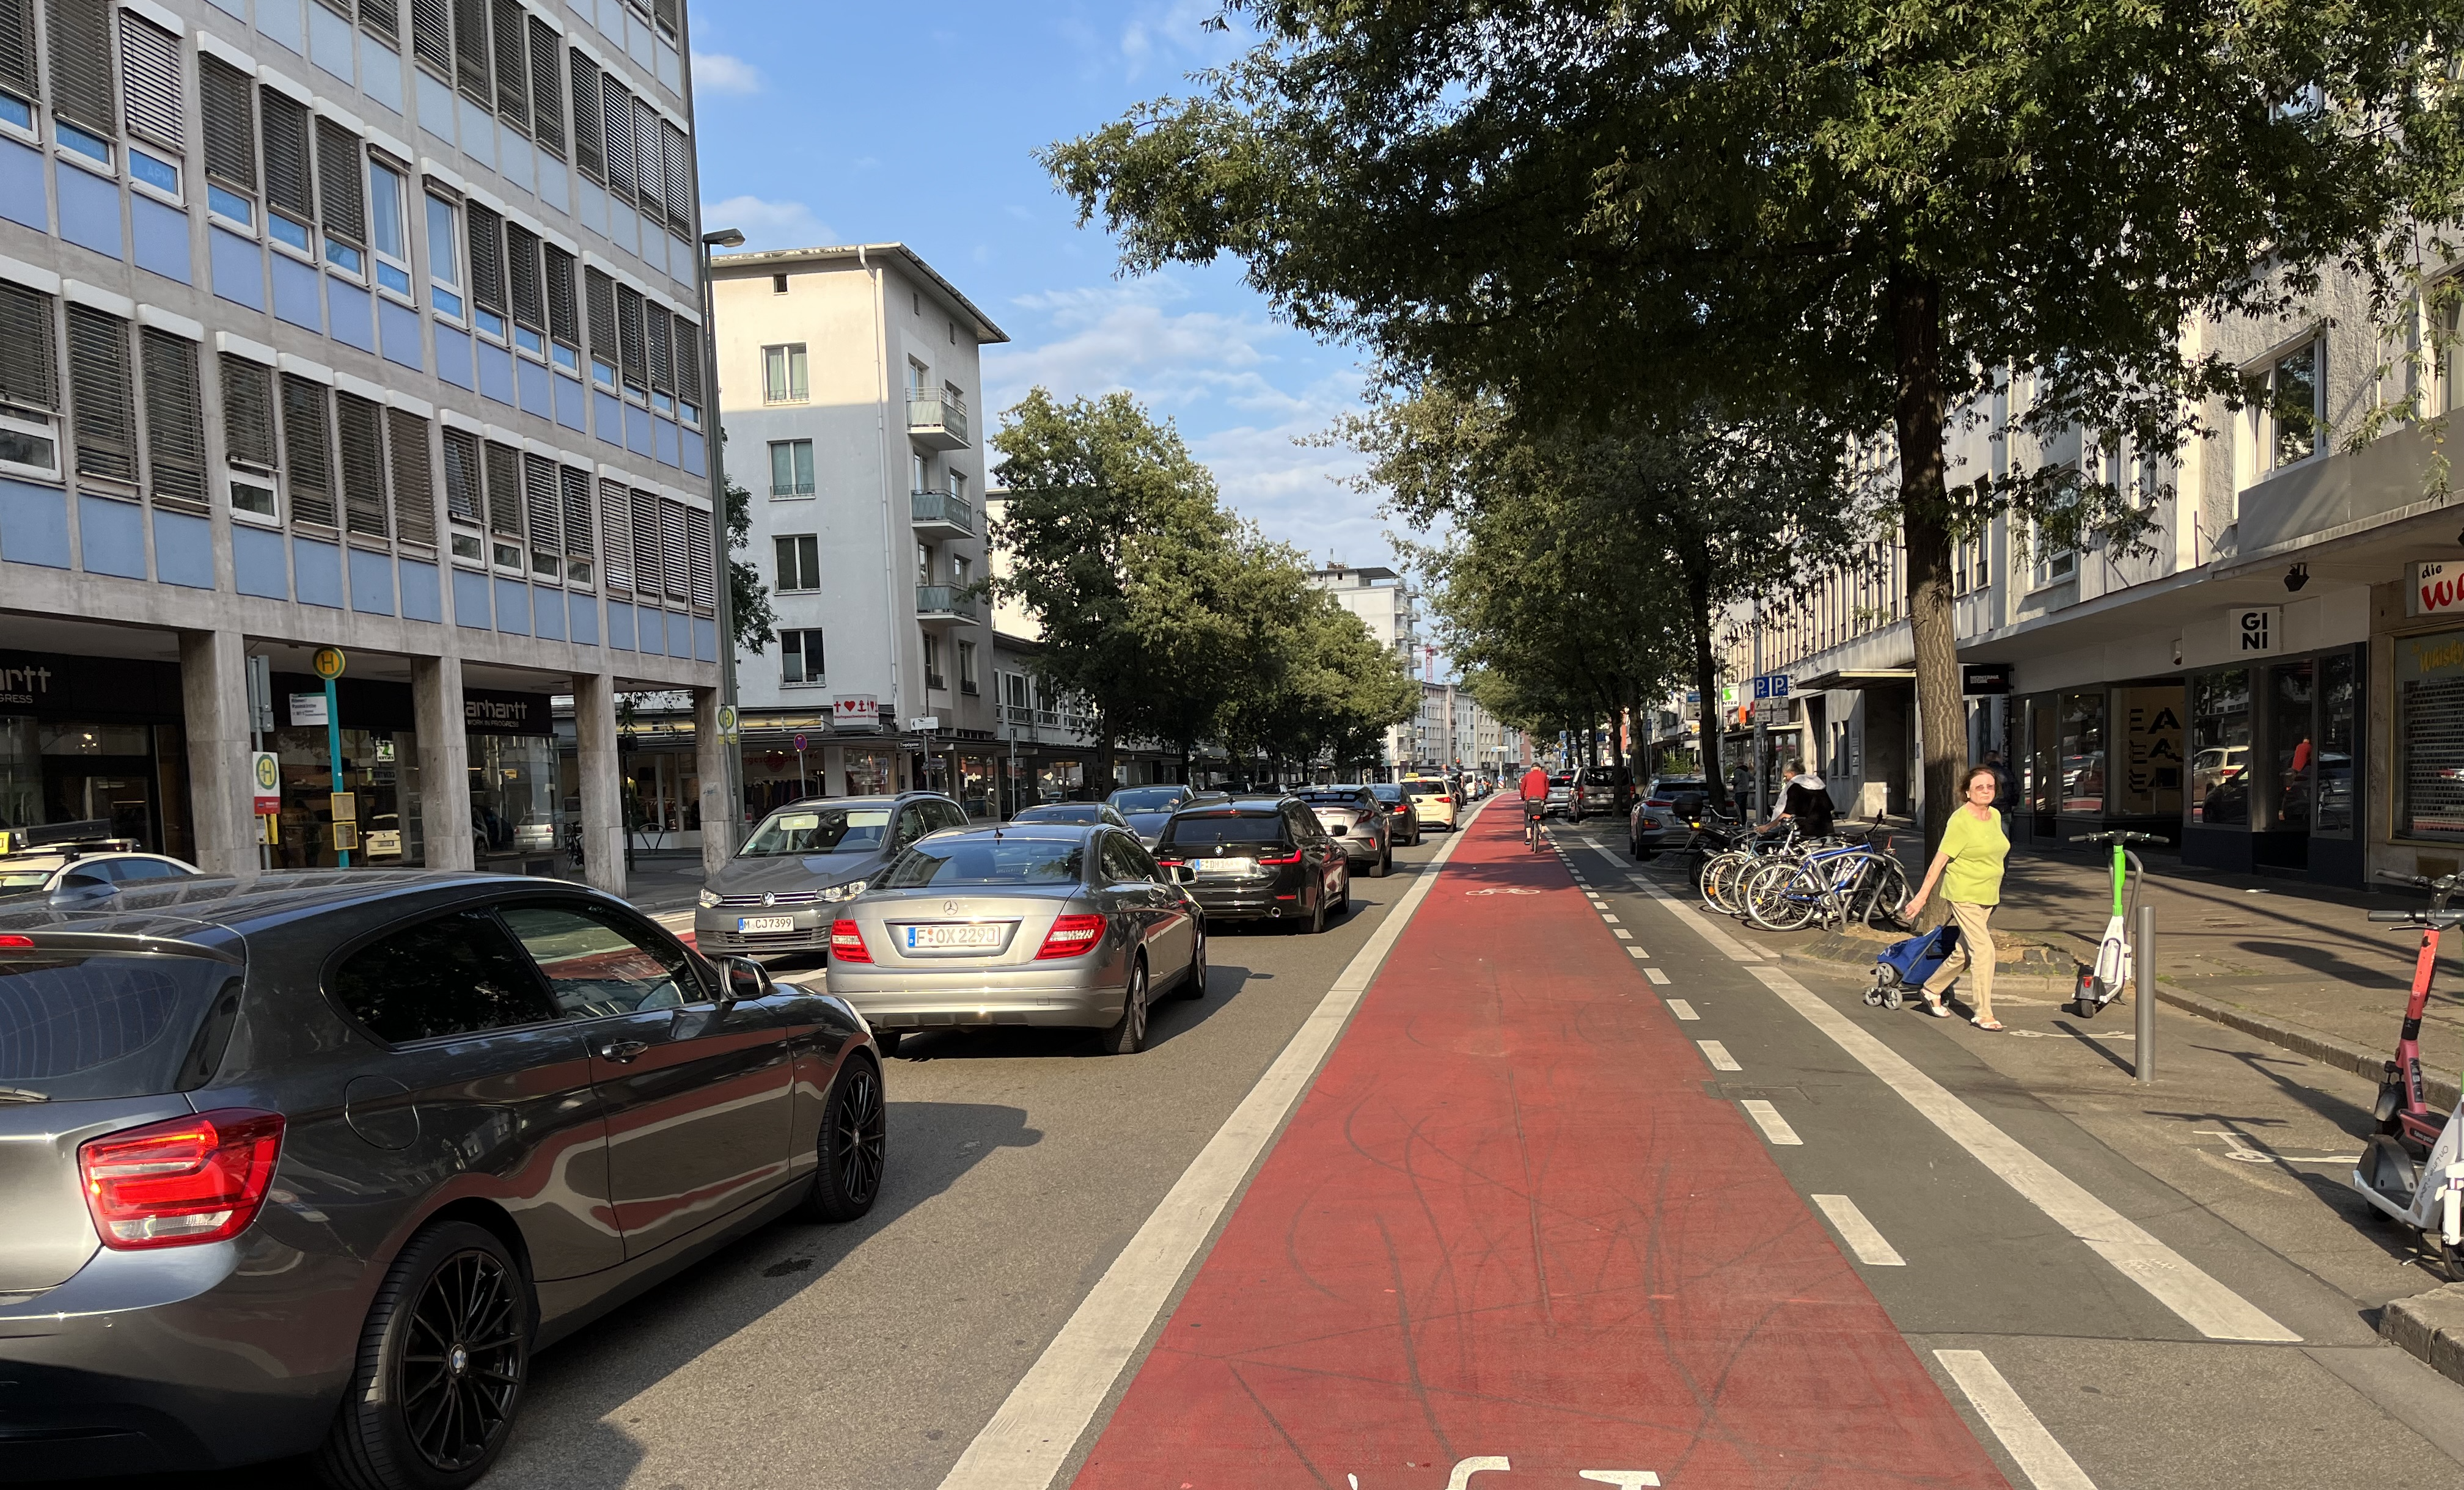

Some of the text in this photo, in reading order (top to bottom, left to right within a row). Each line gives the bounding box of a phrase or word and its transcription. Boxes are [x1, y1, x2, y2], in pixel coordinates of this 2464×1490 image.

[2422, 564, 2442, 579] die
[2242, 613, 2267, 630] GI
[2243, 632, 2267, 650] NI
[321, 653, 334, 671] H
[1756, 679, 1766, 696] P
[1775, 677, 1784, 694] P
[263, 762, 272, 782] H
[744, 918, 791, 929] M CJ 7399
[917, 929, 926, 944] F
[936, 929, 955, 944] OX
